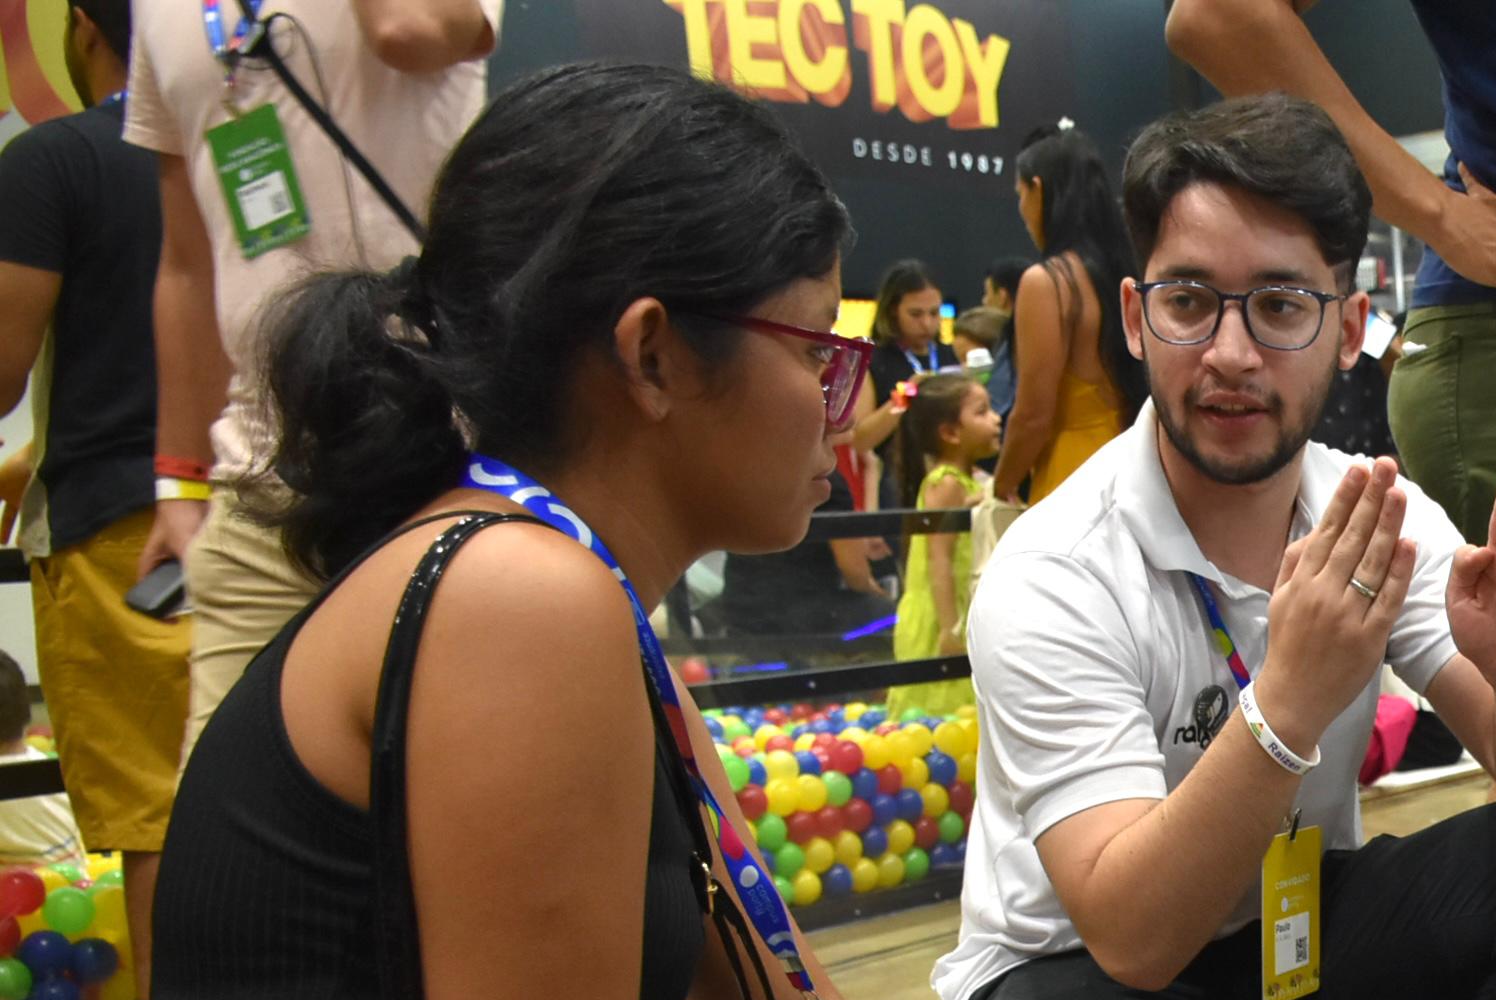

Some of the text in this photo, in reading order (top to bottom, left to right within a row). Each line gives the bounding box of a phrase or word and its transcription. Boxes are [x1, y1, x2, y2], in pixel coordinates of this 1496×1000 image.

[664, 0, 1010, 128] TEC TOY
[852, 137, 1004, 175] DESDE 1987
